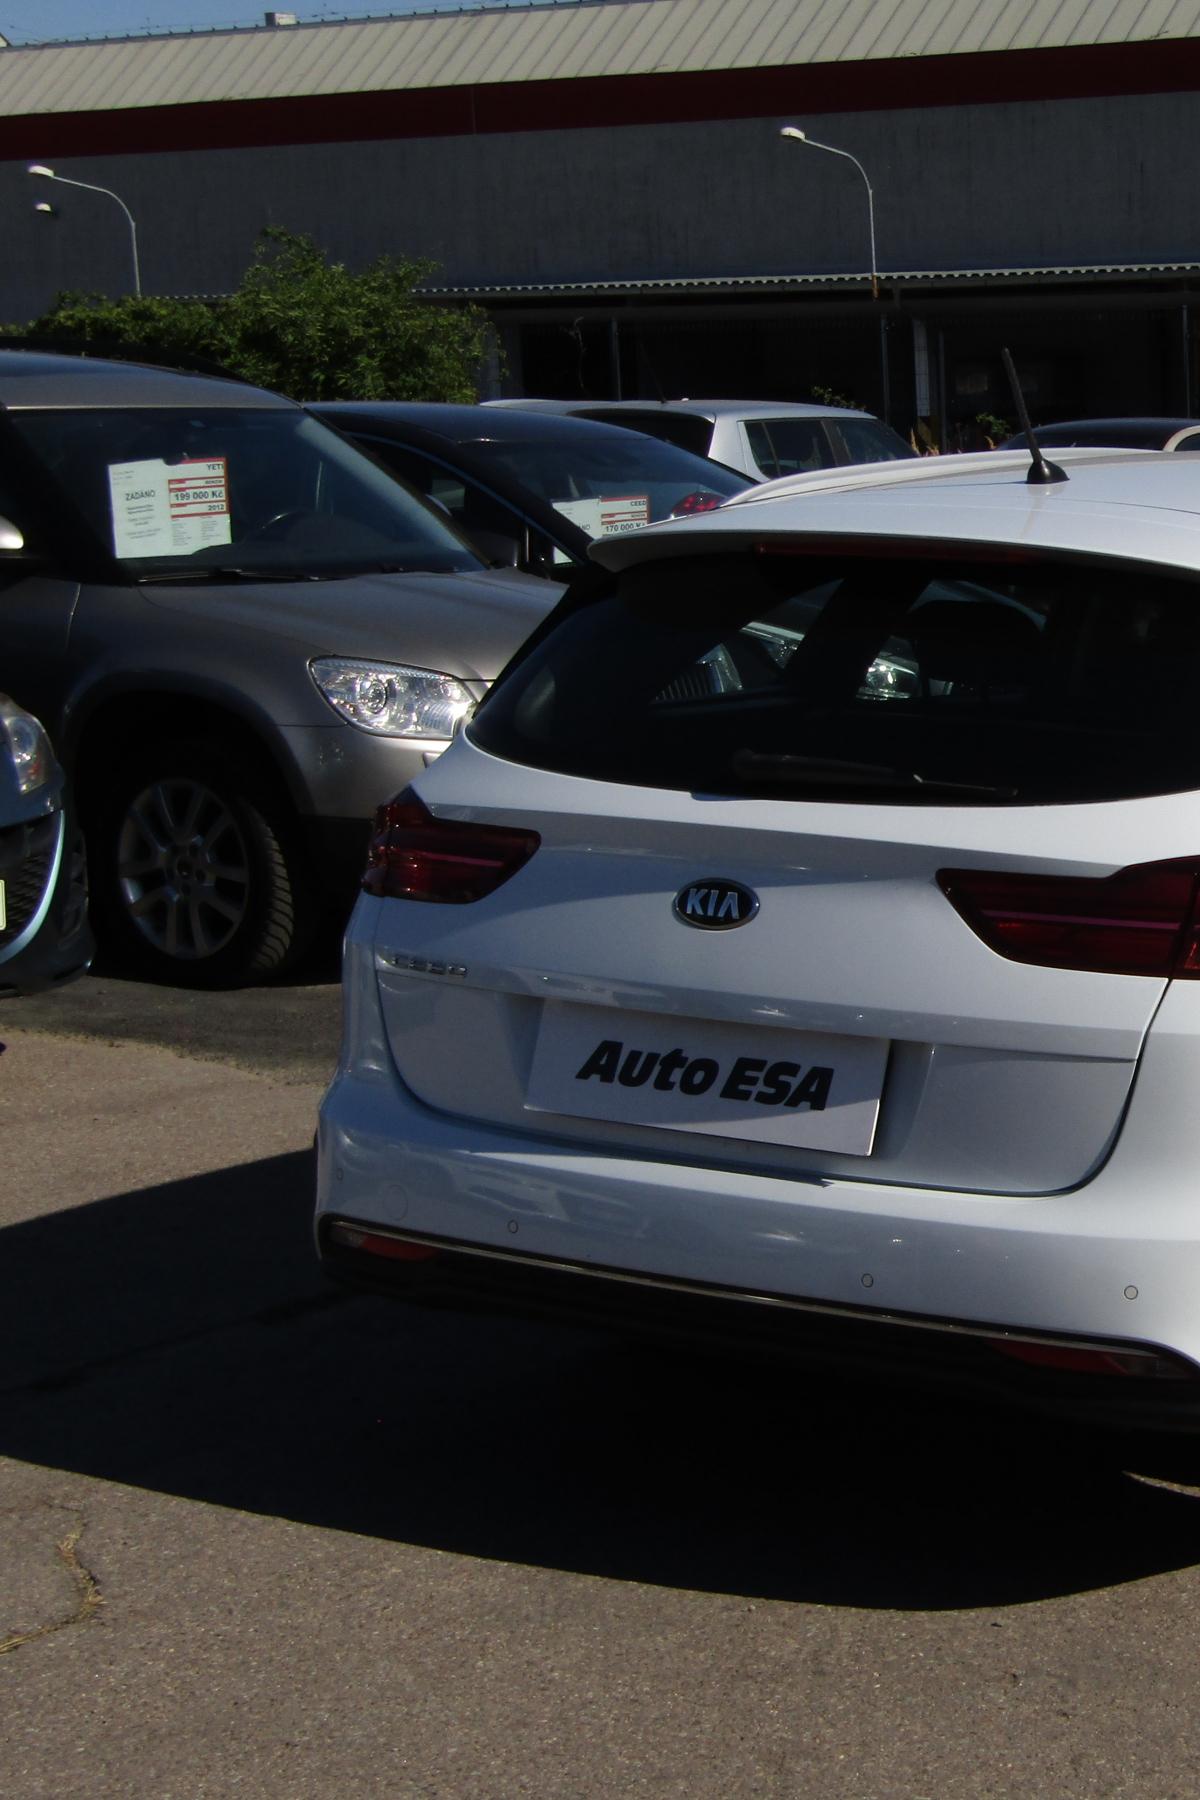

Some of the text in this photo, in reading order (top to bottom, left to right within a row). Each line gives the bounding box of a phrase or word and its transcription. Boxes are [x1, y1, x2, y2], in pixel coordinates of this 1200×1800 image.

[175, 489, 224, 501] 199 000 Kč
[605, 525, 619, 533] 170
[620, 522, 634, 531] 000
[686, 888, 740, 920] KIA
[575, 1039, 834, 1111] Auto ESA
